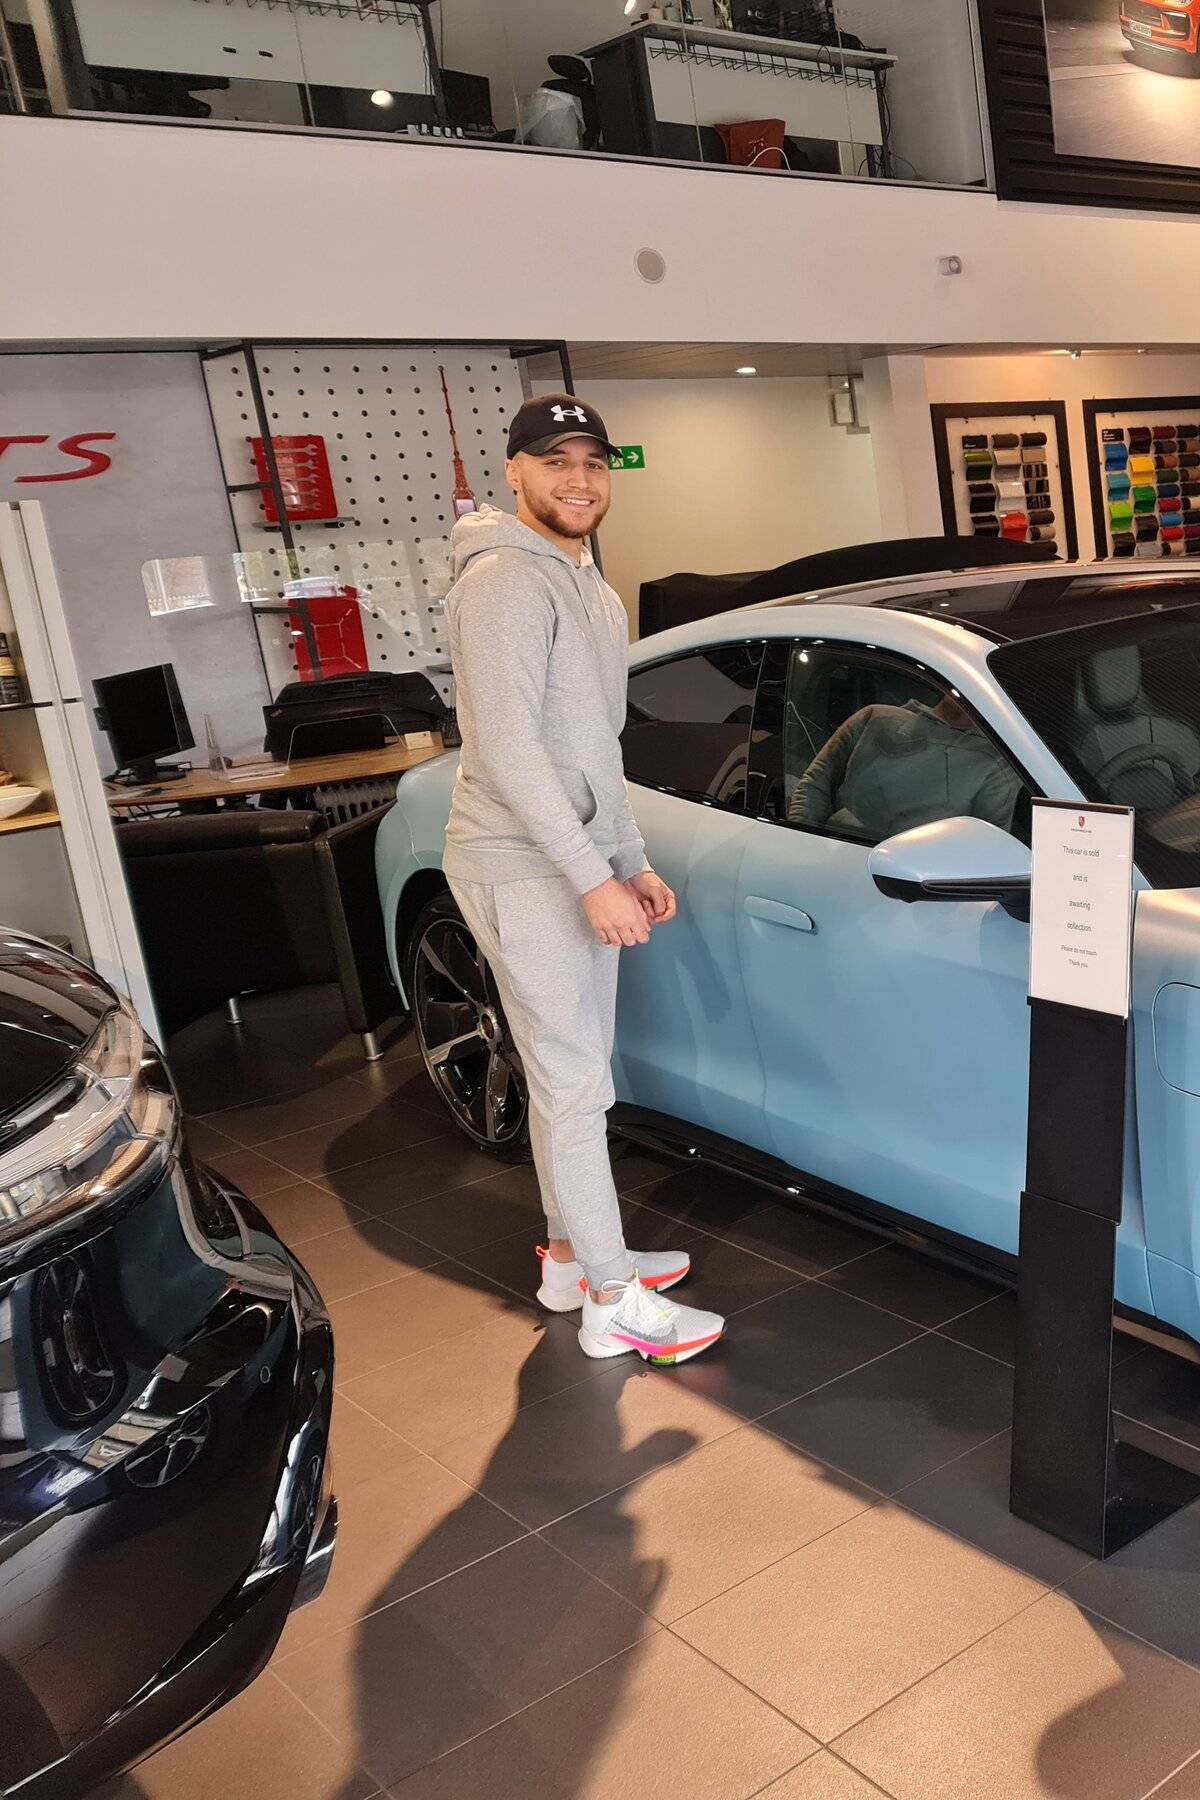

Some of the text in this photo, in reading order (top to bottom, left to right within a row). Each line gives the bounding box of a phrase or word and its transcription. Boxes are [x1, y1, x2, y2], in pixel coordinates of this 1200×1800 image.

[1063, 845, 1073, 855] This
[1074, 848, 1083, 856] car
[1088, 849, 1100, 858] sold
[1072, 874, 1083, 882] and
[1069, 900, 1091, 911] awaiting
